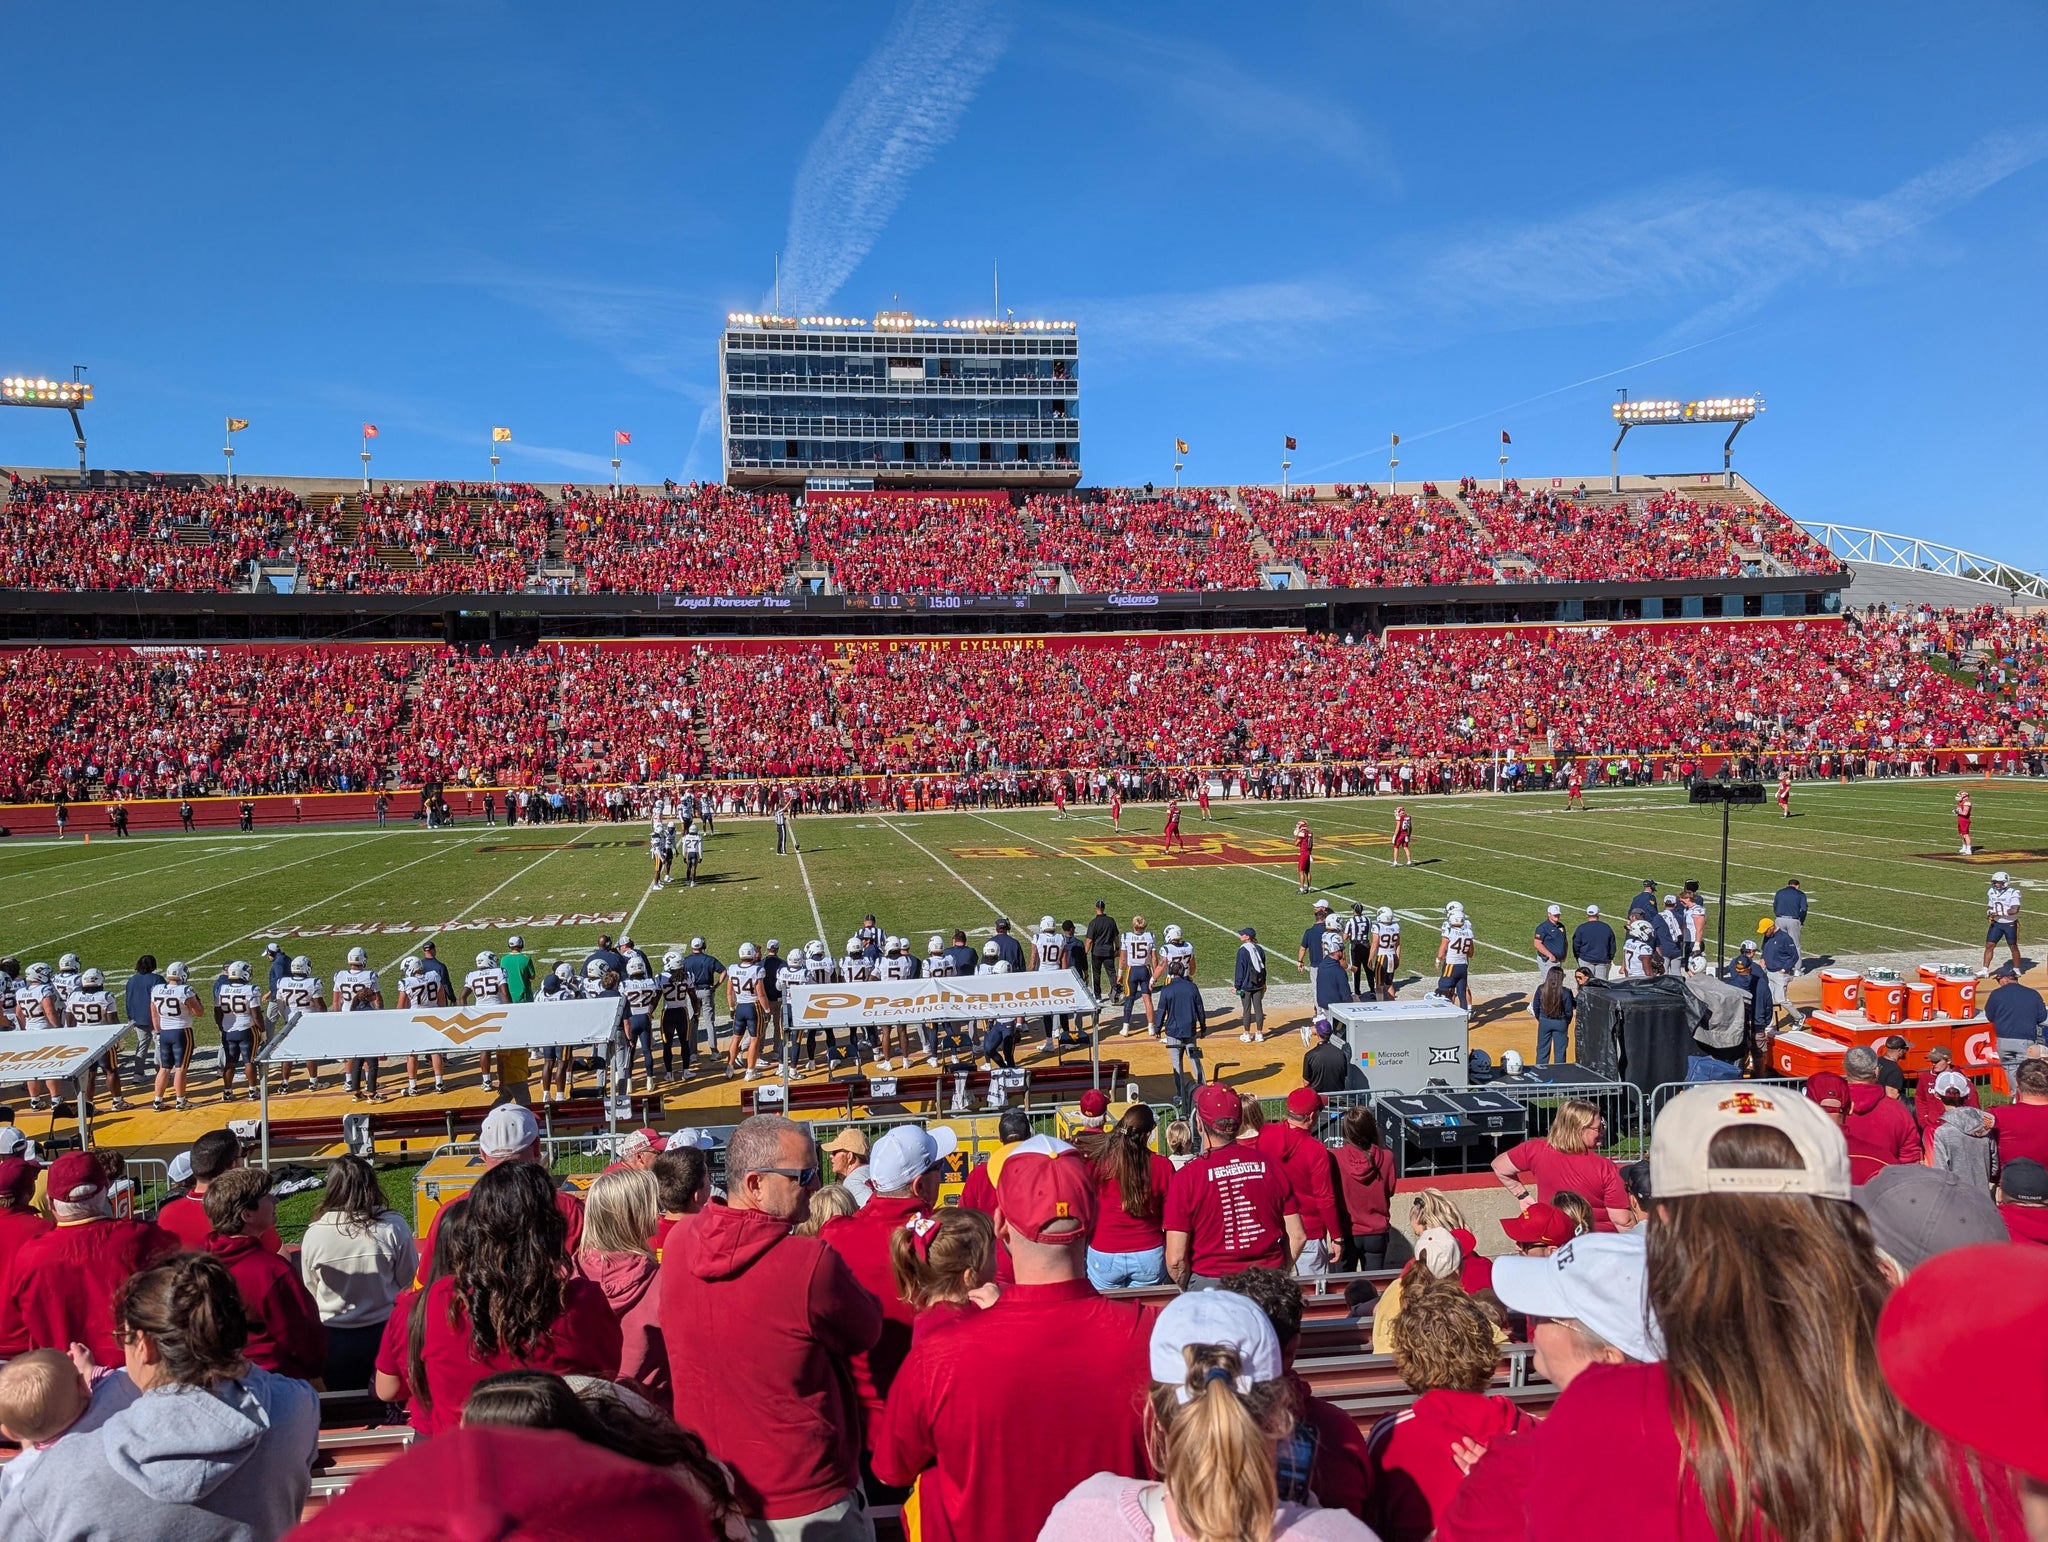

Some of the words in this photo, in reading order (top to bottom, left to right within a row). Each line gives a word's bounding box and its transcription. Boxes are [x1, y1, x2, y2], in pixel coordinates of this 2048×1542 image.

[674, 597, 710, 609] Loyal
[713, 597, 762, 607] Forever
[763, 597, 790, 607] True
[873, 595, 880, 606] 0
[891, 595, 898, 606] 0
[929, 596, 960, 608] 15:00
[1015, 600, 1025, 608] 35
[1108, 594, 1159, 606] Cyclones
[834, 641, 879, 652] HOME
[919, 641, 950, 651] THE
[960, 639, 1045, 651] CYCLONES
[1042, 945, 1058, 962] 10
[1130, 942, 1148, 959] 15
[1450, 938, 1473, 954] 48
[847, 966, 867, 981] 14
[887, 967, 900, 981] 5
[412, 981, 438, 1004] 78
[471, 976, 499, 998] 65
[662, 984, 688, 1001] 28
[731, 976, 756, 995] 84
[154, 996, 181, 1016] 79
[219, 995, 247, 1014] 56
[282, 989, 311, 1007] 72
[862, 986, 1075, 1009] Panhandle
[72, 1003, 102, 1023] 59
[862, 1003, 945, 1018] CLEANING
[951, 1003, 961, 1012] &
[967, 997, 1076, 1011] RESTORATION
[1378, 1050, 1410, 1058] Microsoft
[1214, 1164, 1262, 1179] SCHEDULE
